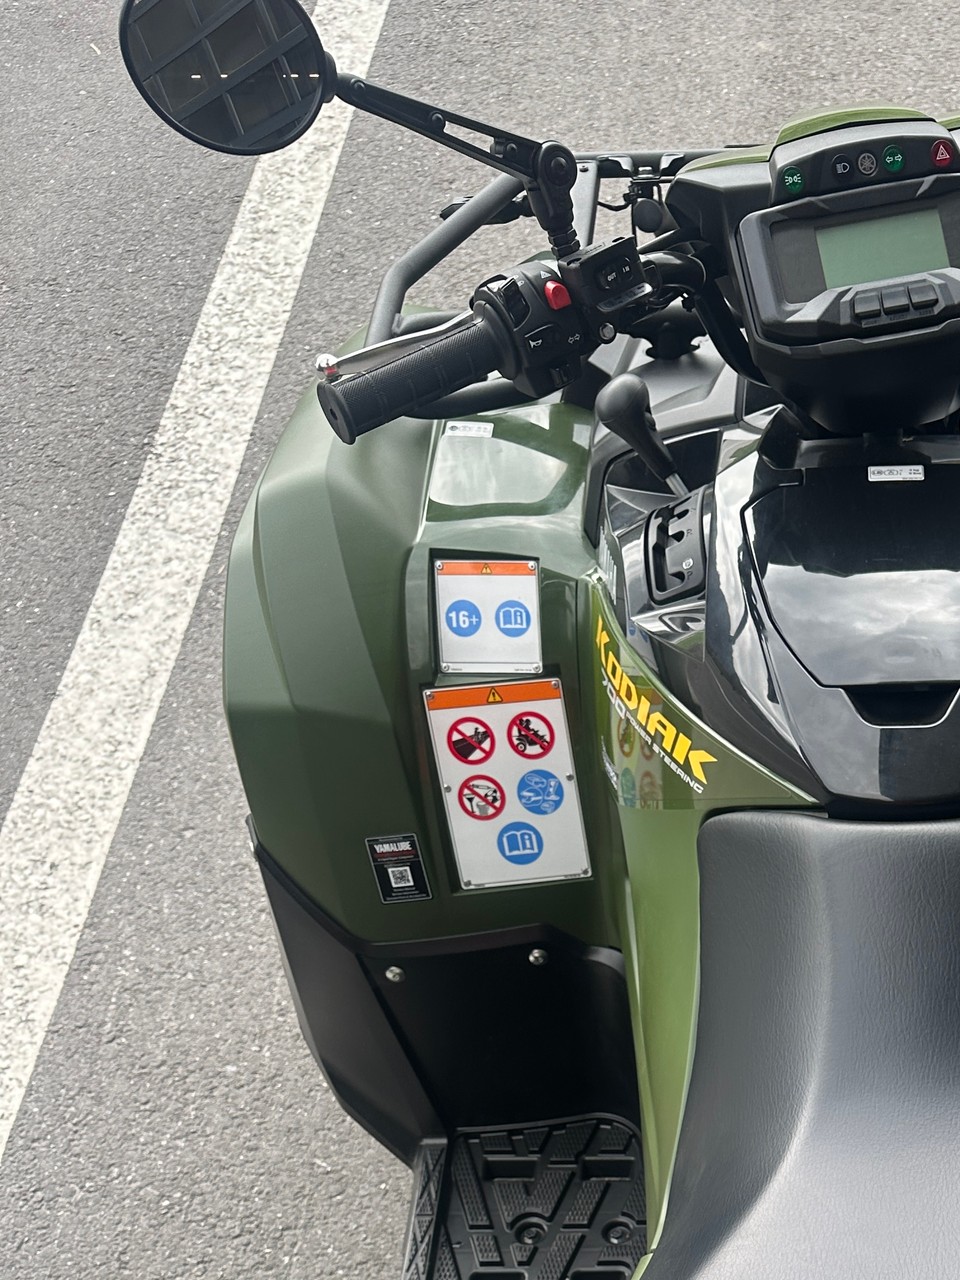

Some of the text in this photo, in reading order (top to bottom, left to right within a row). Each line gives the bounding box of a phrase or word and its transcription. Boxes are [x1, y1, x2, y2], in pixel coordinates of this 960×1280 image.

[448, 610, 480, 629] 16+
[596, 614, 719, 785] KODIAK
[626, 712, 652, 746] POWER
[652, 743, 705, 795] STEERING
